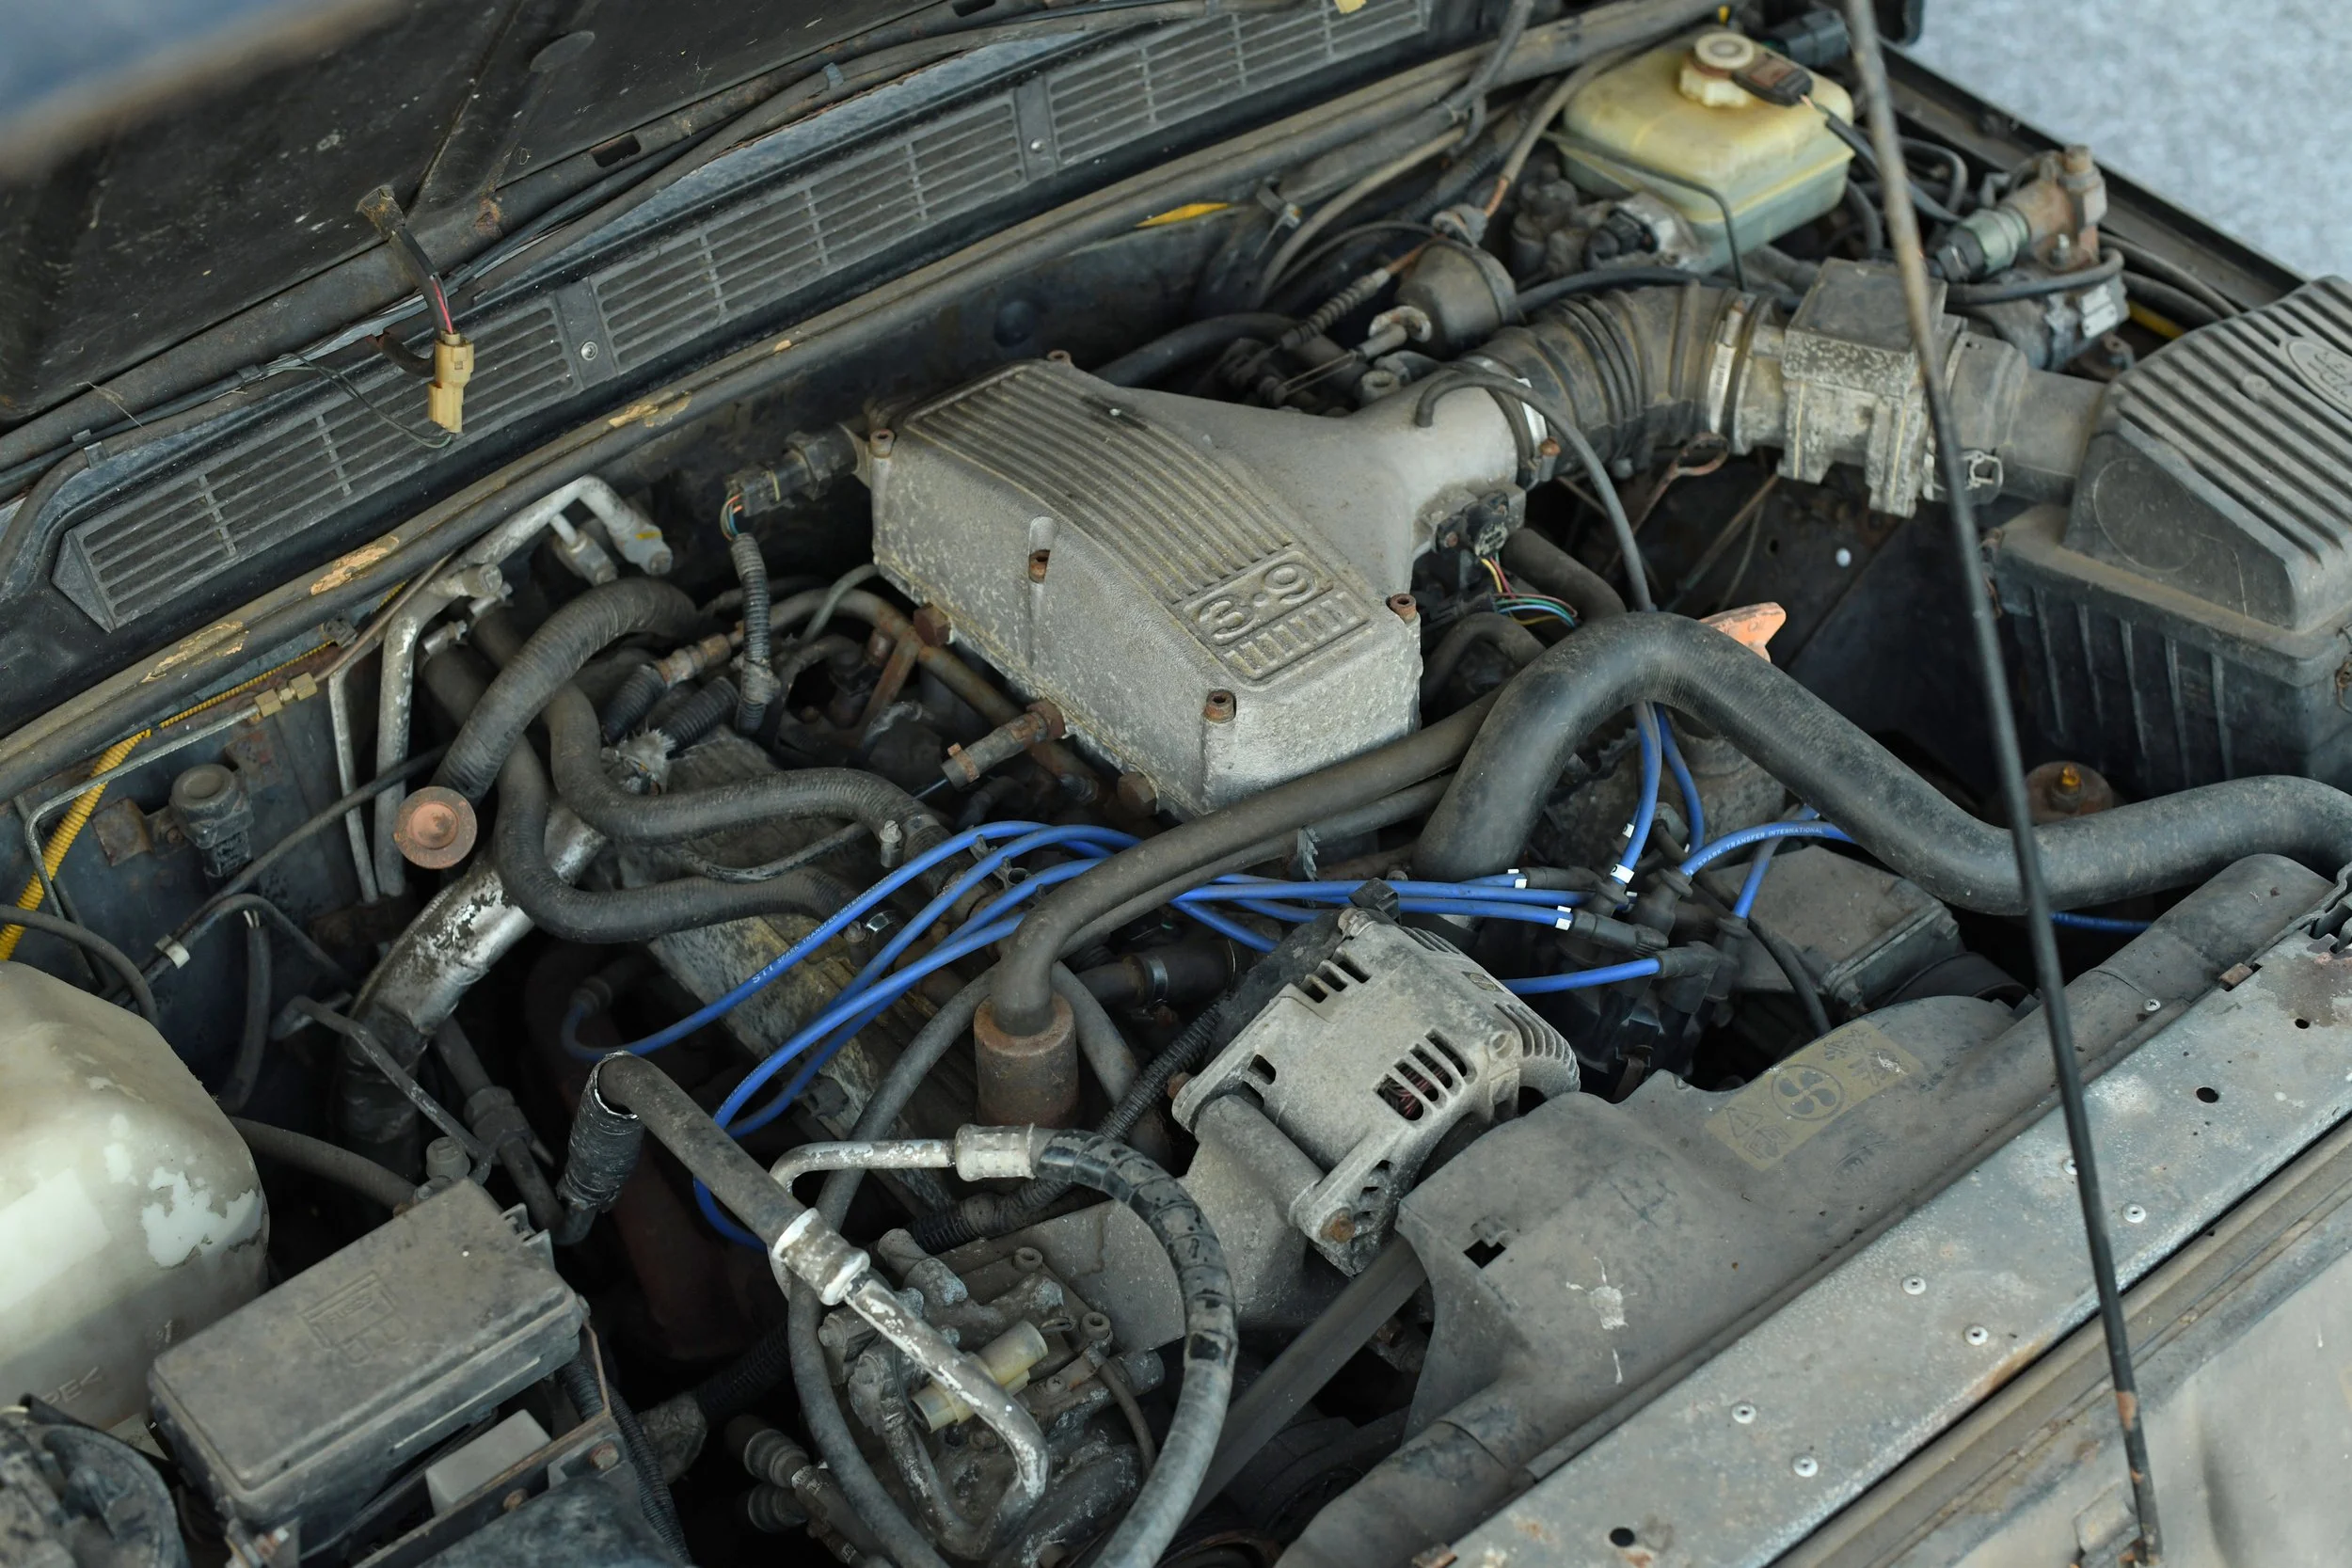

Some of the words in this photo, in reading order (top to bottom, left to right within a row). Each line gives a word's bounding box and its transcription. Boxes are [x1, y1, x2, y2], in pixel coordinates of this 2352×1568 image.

[1199, 562, 1318, 646] 3.9
[1697, 848, 1723, 866] SPARK
[1726, 832, 1766, 850] TRANSFER
[1768, 827, 1823, 837] INTERNATIONAL
[777, 945, 800, 964] SPARK
[802, 914, 838, 944] TRANSFER
